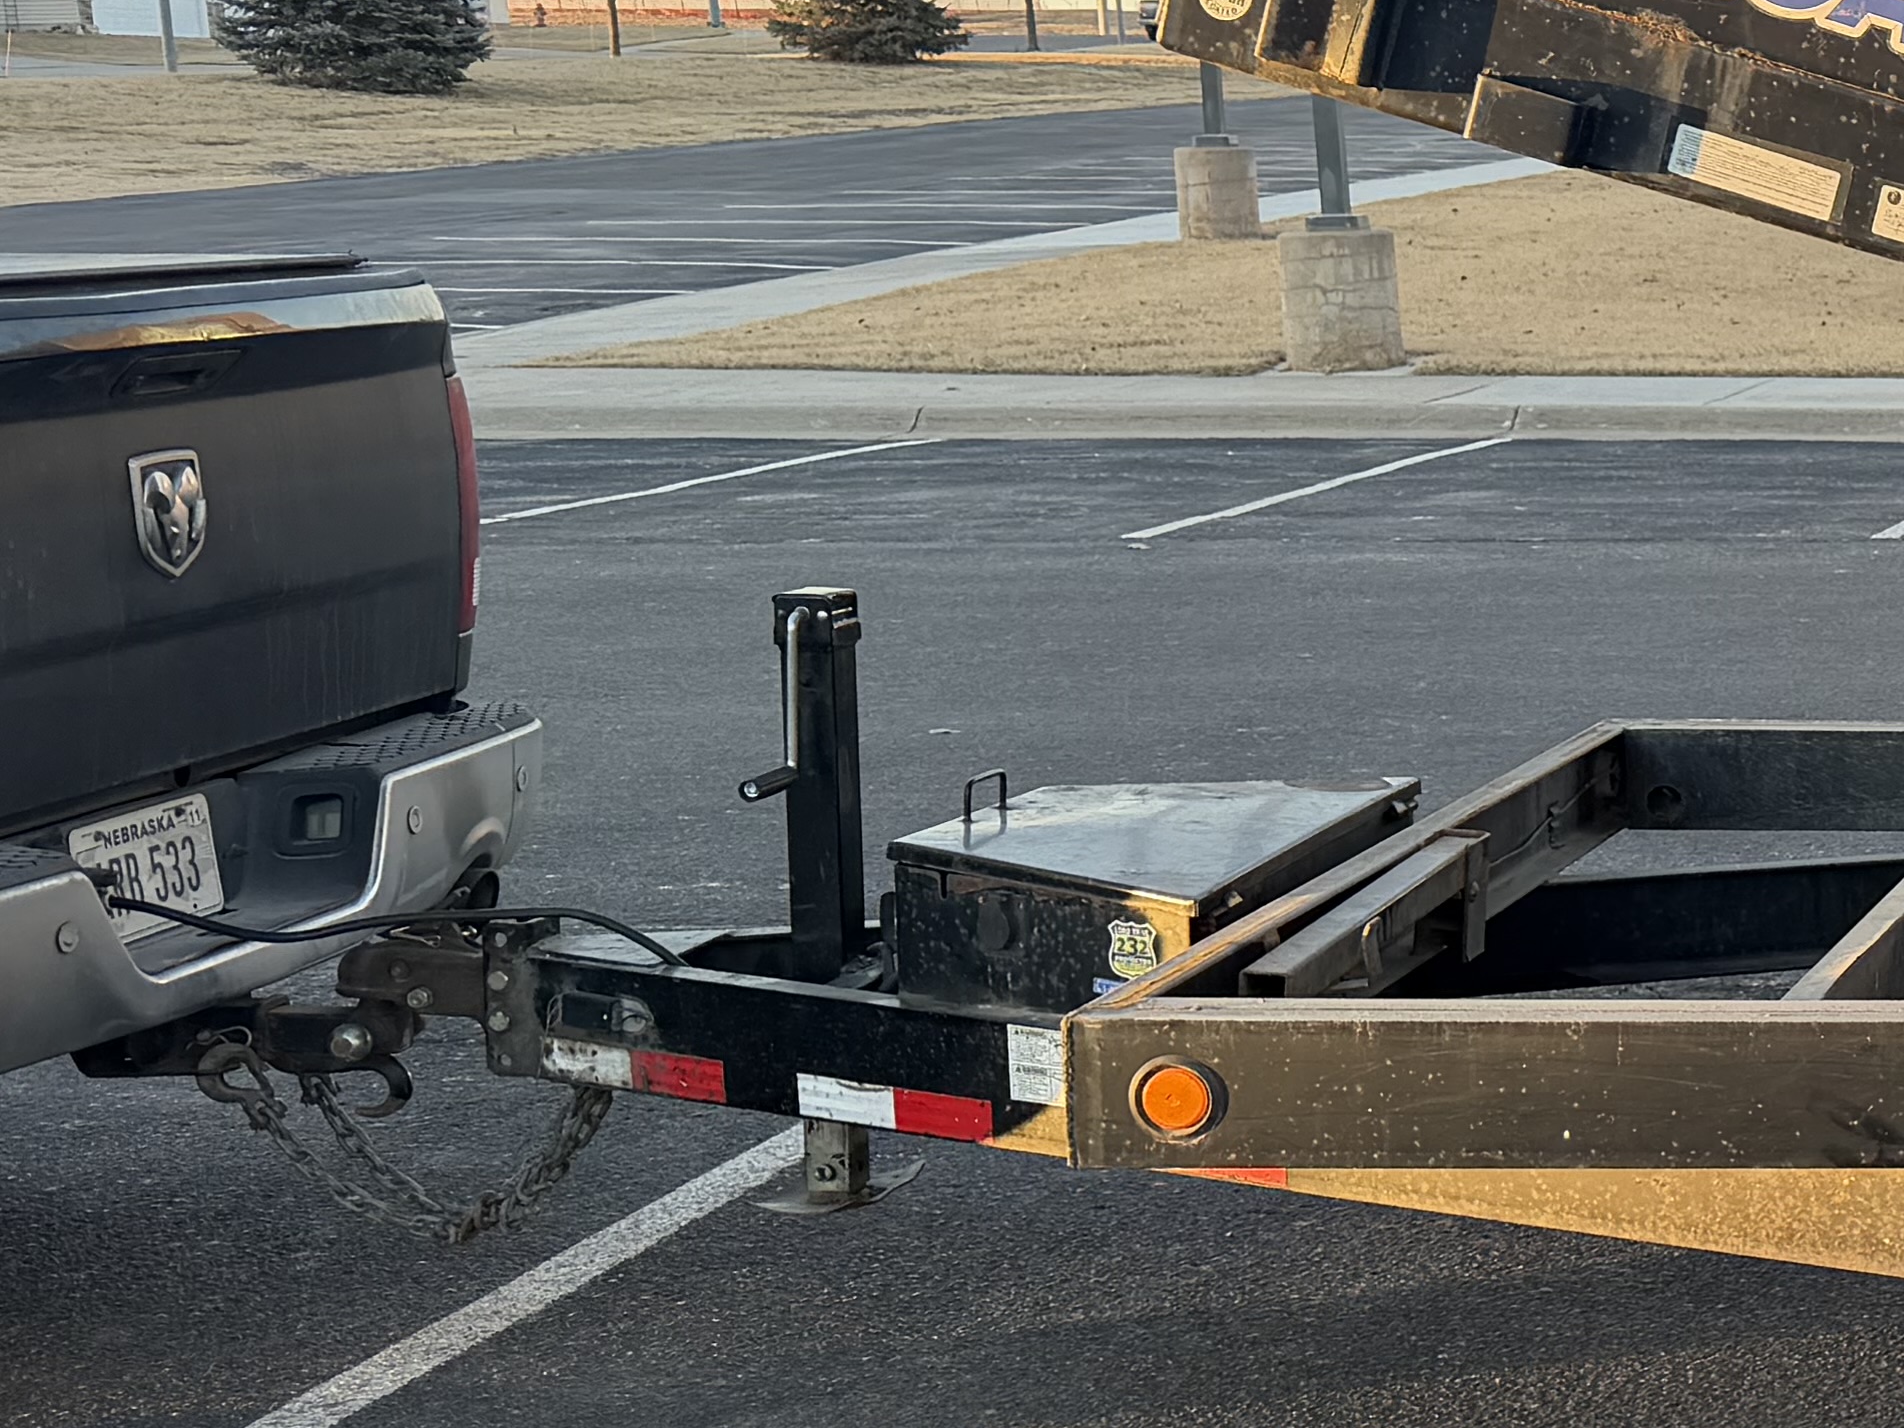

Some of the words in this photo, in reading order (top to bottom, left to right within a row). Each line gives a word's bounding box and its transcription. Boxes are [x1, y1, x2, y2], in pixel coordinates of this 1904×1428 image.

[102, 815, 176, 849] NEBRASKA
[148, 836, 200, 902] 533
[1117, 937, 1148, 955] 232
